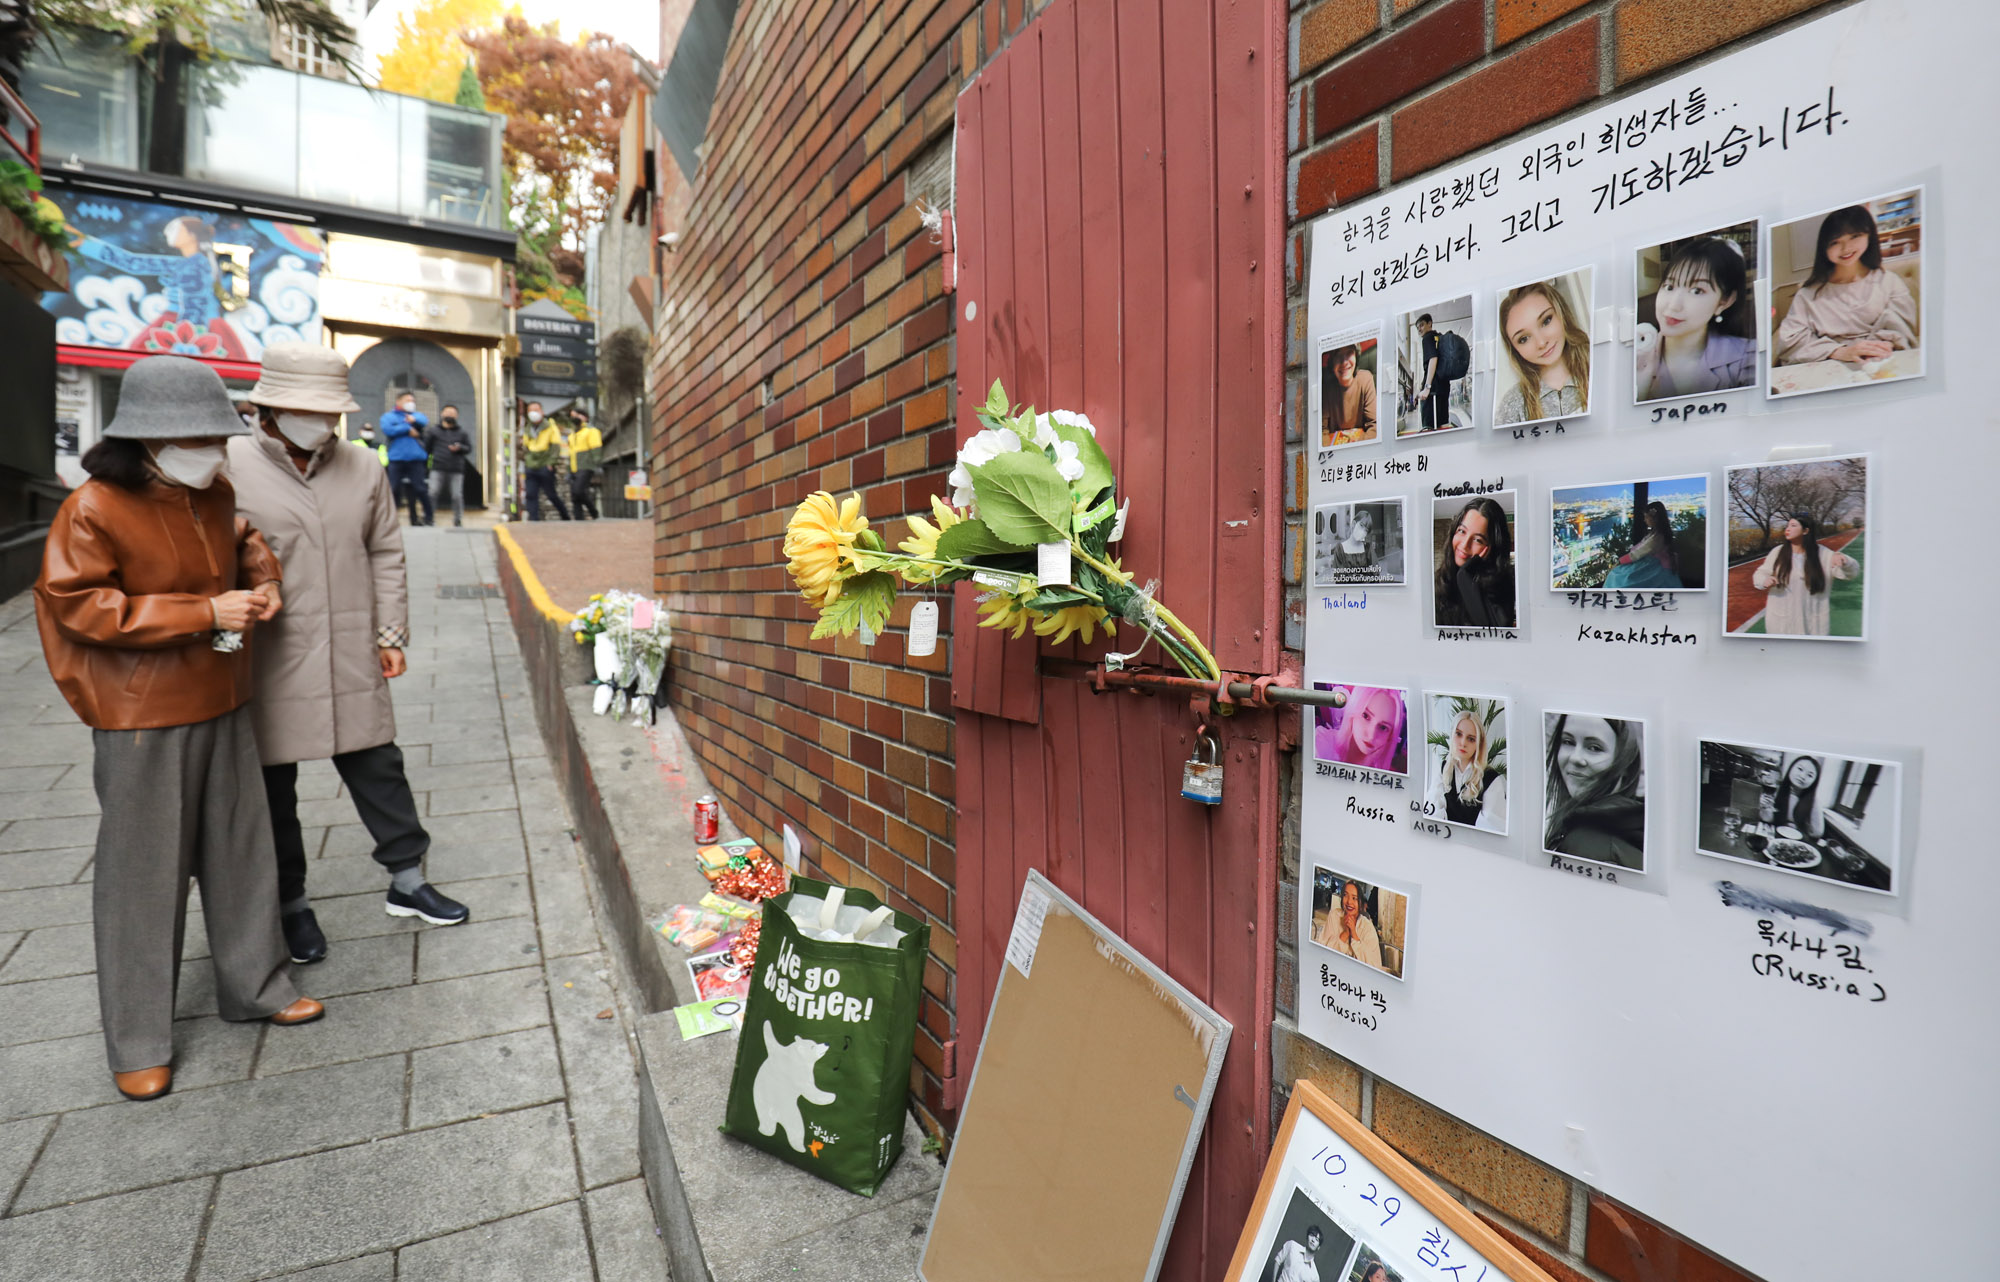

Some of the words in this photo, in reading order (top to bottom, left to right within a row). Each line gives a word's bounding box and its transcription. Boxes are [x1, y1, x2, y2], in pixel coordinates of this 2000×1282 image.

[1330, 270, 1365, 306] 잊지
[1373, 223, 1481, 292] 않겠습니다.
[1501, 198, 1564, 243] 그리고
[1591, 85, 1849, 214] 기도하겠습니다.
[1342, 206, 1391, 252] 한국을
[1404, 167, 1500, 223] 사랑했던
[1518, 132, 1586, 181] 외국인
[523, 318, 582, 335] DISTRICT
[1651, 401, 1728, 423] Japan
[1321, 590, 1367, 610] Thailand
[1577, 624, 1697, 646] Kazakhstan
[1315, 763, 1358, 782] 크리스티나
[1345, 796, 1396, 824] Russia
[1550, 854, 1618, 884] Russia
[1757, 919, 1828, 960] 옥사나
[777, 935, 801, 980] We
[804, 966, 841, 992] go
[1752, 953, 1887, 1002] (Russia)
[1321, 993, 1377, 1031] (Russia)
[1370, 989, 1387, 1014] 박
